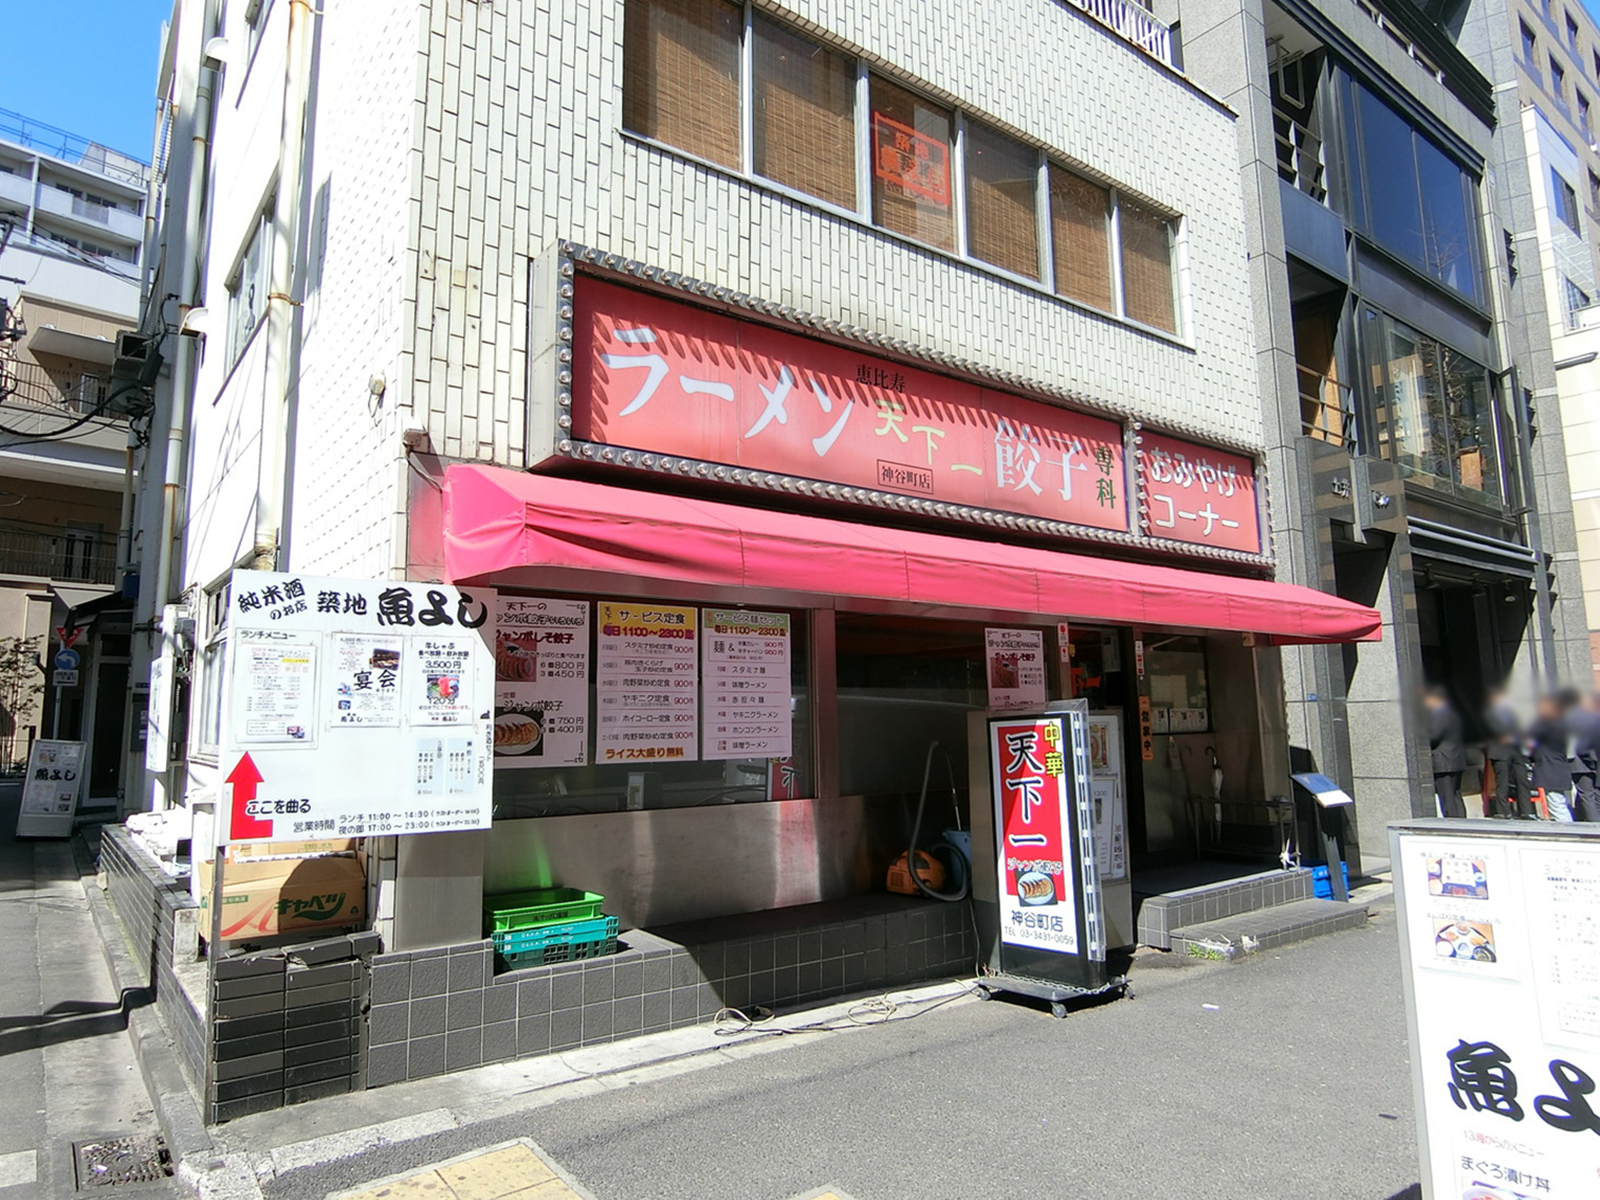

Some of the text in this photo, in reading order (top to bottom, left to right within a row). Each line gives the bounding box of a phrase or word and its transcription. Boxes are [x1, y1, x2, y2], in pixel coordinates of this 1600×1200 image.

[855, 364, 906, 393] 恵比寿
[600, 327, 1117, 510] ラーメン 天下一 餃子 専科
[880, 464, 931, 490] 神谷町店
[1150, 446, 1236, 497] おみやげ
[1154, 494, 1239, 536] コーナー
[237, 578, 306, 614] 純米酒
[270, 599, 308, 620] のお店
[317, 587, 488, 629] 築地 魚よし
[505, 602, 547, 611] 天下一の
[619, 610, 685, 625] サービス定食
[240, 630, 296, 640] ランチメニュー
[674, 645, 694, 654] 900円
[674, 662, 694, 671] 900円
[353, 669, 397, 691] 宴会
[674, 679, 694, 688] 900円
[732, 681, 768, 689] 味噌ラーメン
[674, 697, 694, 705] 900円
[674, 714, 694, 722] 900円
[732, 711, 778, 719] ヤキニクラーメン
[675, 731, 694, 740] 900円
[732, 741, 768, 749] 味噌ラーメン
[1044, 721, 1064, 778] 中華
[605, 747, 684, 760] ライス大盛り無料
[35, 767, 76, 781] 魚よし
[1006, 730, 1048, 846] 天下一
[246, 799, 312, 815] ここを曲る
[339, 814, 365, 824] ランチ
[368, 812, 391, 821] 11:00
[404, 810, 429, 819] 14:30
[293, 818, 335, 833] 営業時間
[338, 824, 365, 835] 夜の部
[368, 822, 392, 832] 17:00
[405, 820, 430, 830] 23:00
[274, 892, 347, 921] キャベツ
[1011, 909, 1064, 934] 神谷町店
[1004, 925, 1075, 946] TEL 03-3431-0059
[1460, 1155, 1551, 1193] まぐろ漬け丼
